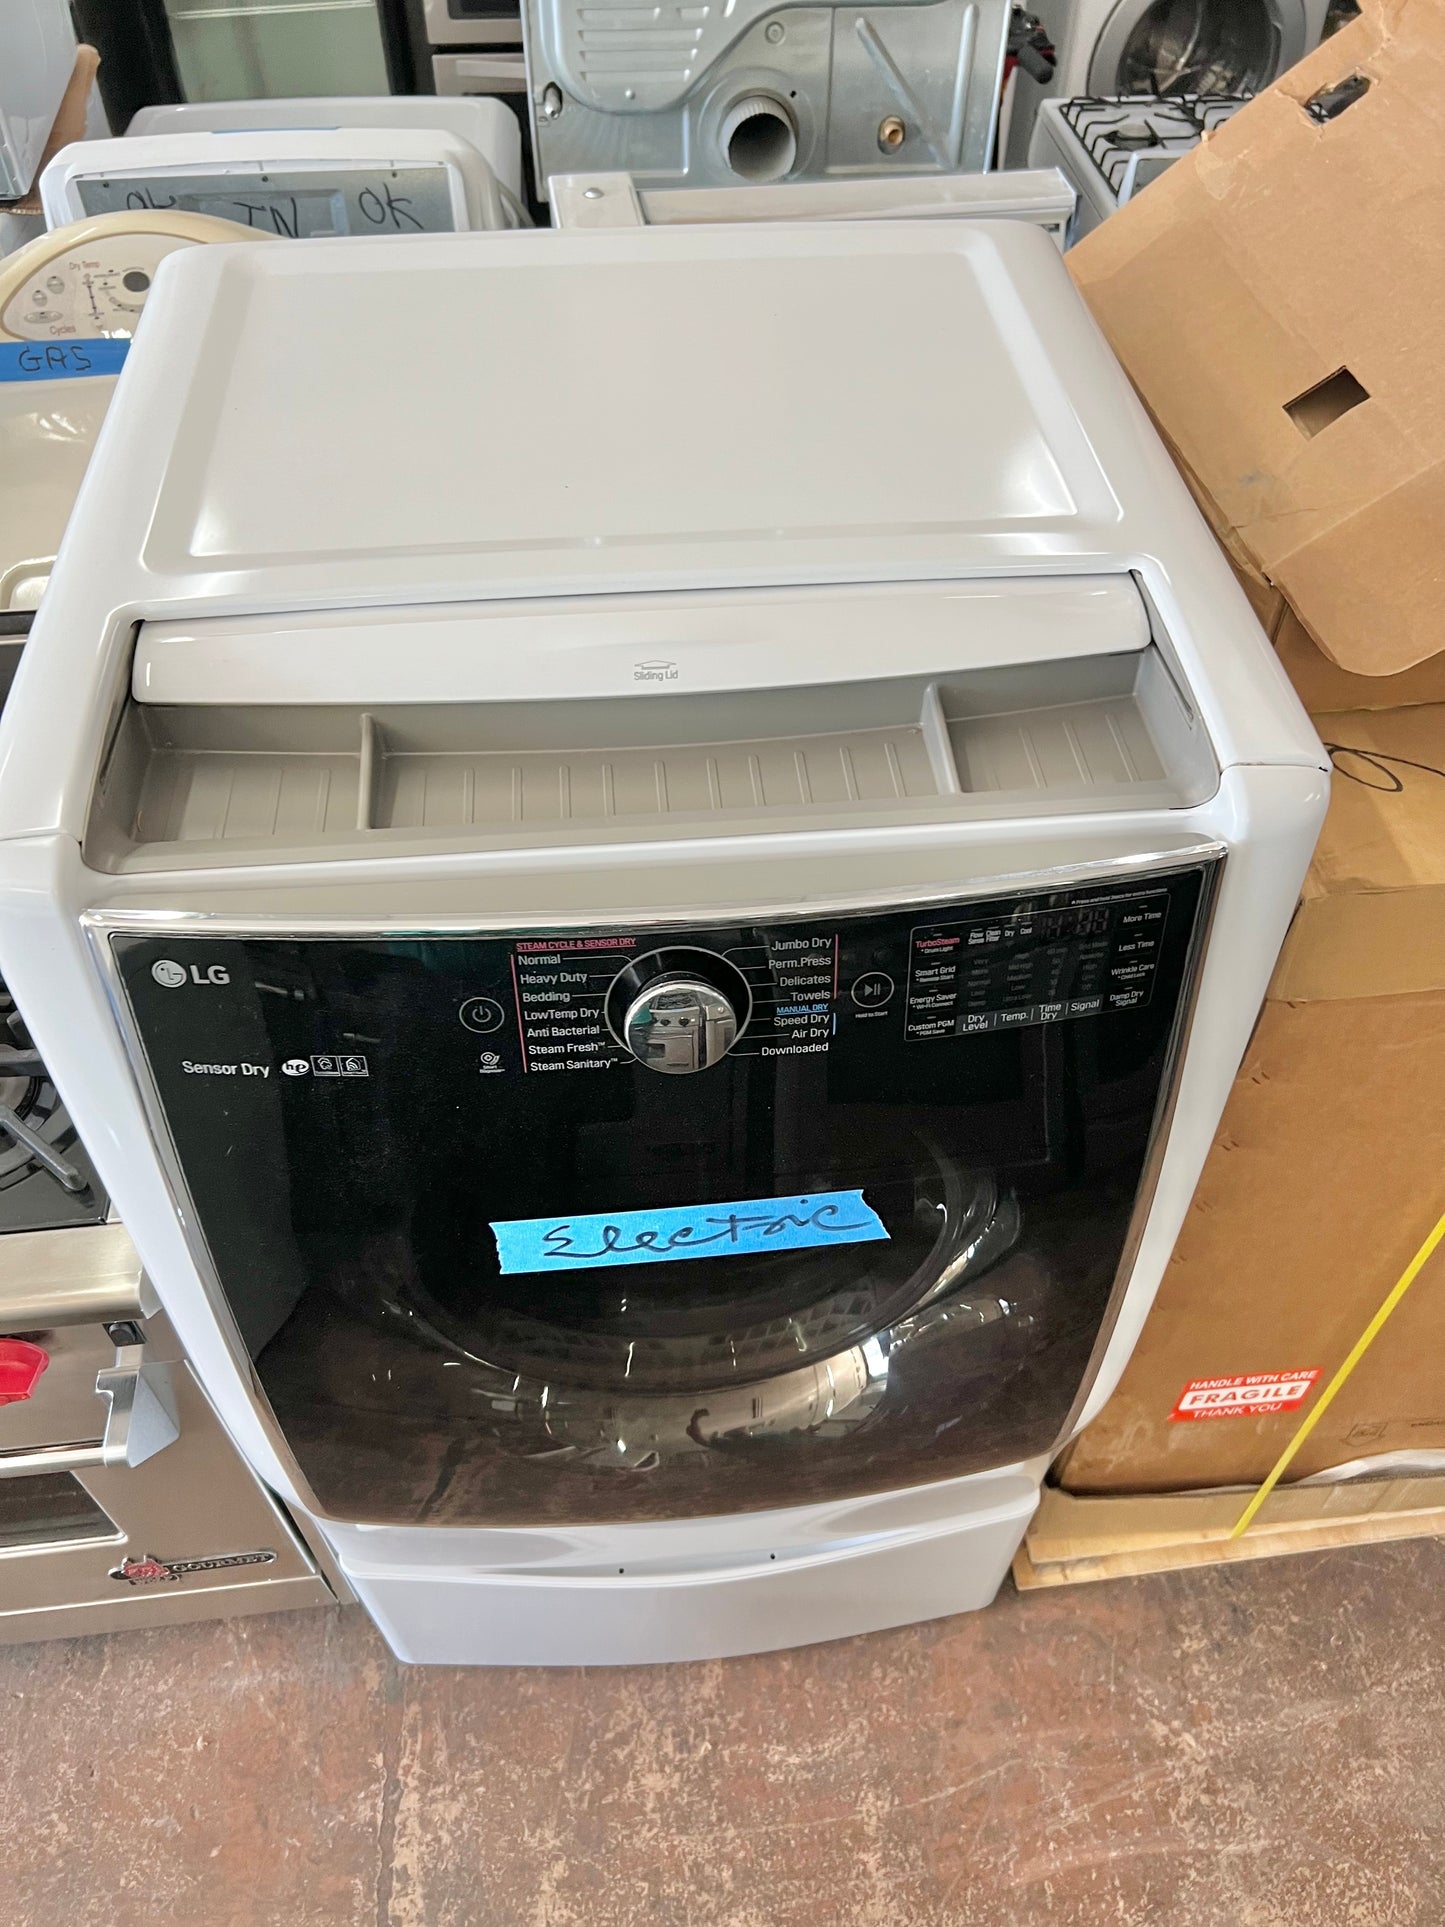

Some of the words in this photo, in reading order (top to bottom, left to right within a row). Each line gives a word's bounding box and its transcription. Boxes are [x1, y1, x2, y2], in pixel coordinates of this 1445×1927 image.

[359, 183, 424, 231] OK
[50, 325, 77, 336] Cycles
[18, 346, 92, 372] GAS
[633, 671, 663, 681] Sliding
[665, 670, 679, 679] Lid
[1123, 915, 1142, 923] More
[1144, 912, 1162, 920] Time
[516, 942, 547, 951] STEAM
[549, 941, 575, 949] CYCLE
[577, 940, 583, 948] &
[585, 939, 619, 948] SENSOR
[619, 938, 636, 946] DRY
[771, 939, 809, 951] Jumbo
[811, 938, 832, 949] Dry
[915, 937, 960, 948] TurboSteam
[1118, 943, 1136, 951] Less
[1137, 941, 1154, 949] Time
[518, 954, 561, 966] Normal
[915, 968, 939, 977] Smart
[939, 965, 956, 974] Grid
[1139, 963, 1155, 971] Care
[190, 964, 230, 985] LG
[520, 974, 558, 985] Heavy
[560, 972, 588, 983] Duty
[780, 974, 831, 987] Delicates
[522, 991, 571, 1003] Bedding
[790, 990, 831, 1001] Towels
[910, 996, 936, 1005] Energy
[936, 993, 957, 1001] Saver
[1110, 993, 1130, 1002] Damp
[1131, 991, 1144, 999] Dry
[1039, 1003, 1062, 1013] Time
[1071, 1000, 1100, 1012] Signal
[1116, 997, 1138, 1007] Signal
[580, 1008, 599, 1020] Dry
[776, 1005, 811, 1014] MANUAL
[812, 1003, 829, 1012] DRY
[773, 1015, 808, 1028] Speed
[810, 1014, 829, 1024] Dry
[968, 1014, 985, 1024] Dry
[1000, 1012, 1029, 1023] Temp.
[1041, 1011, 1057, 1021] Dry
[908, 1023, 936, 1031] Custom
[937, 1019, 955, 1028] PGM
[962, 1020, 988, 1032] Level
[527, 1027, 550, 1038] Anti
[551, 1025, 600, 1037] Bacterial
[791, 1029, 808, 1039] Air
[810, 1028, 830, 1039] Dry
[528, 1045, 565, 1055] Steam
[761, 1042, 829, 1057] Downloaded
[182, 1060, 238, 1075] Sensor
[240, 1063, 270, 1078] Dry
[530, 1062, 565, 1072] Steam
[543, 1199, 872, 1258] Electric
[1190, 1378, 1243, 1390] HANDLE
[1245, 1374, 1280, 1384] WITH
[1280, 1370, 1319, 1380] CARE
[1189, 1385, 1304, 1406] FRAGILE
[1193, 1405, 1244, 1418] THANK
[1249, 1402, 1282, 1412] YOU
